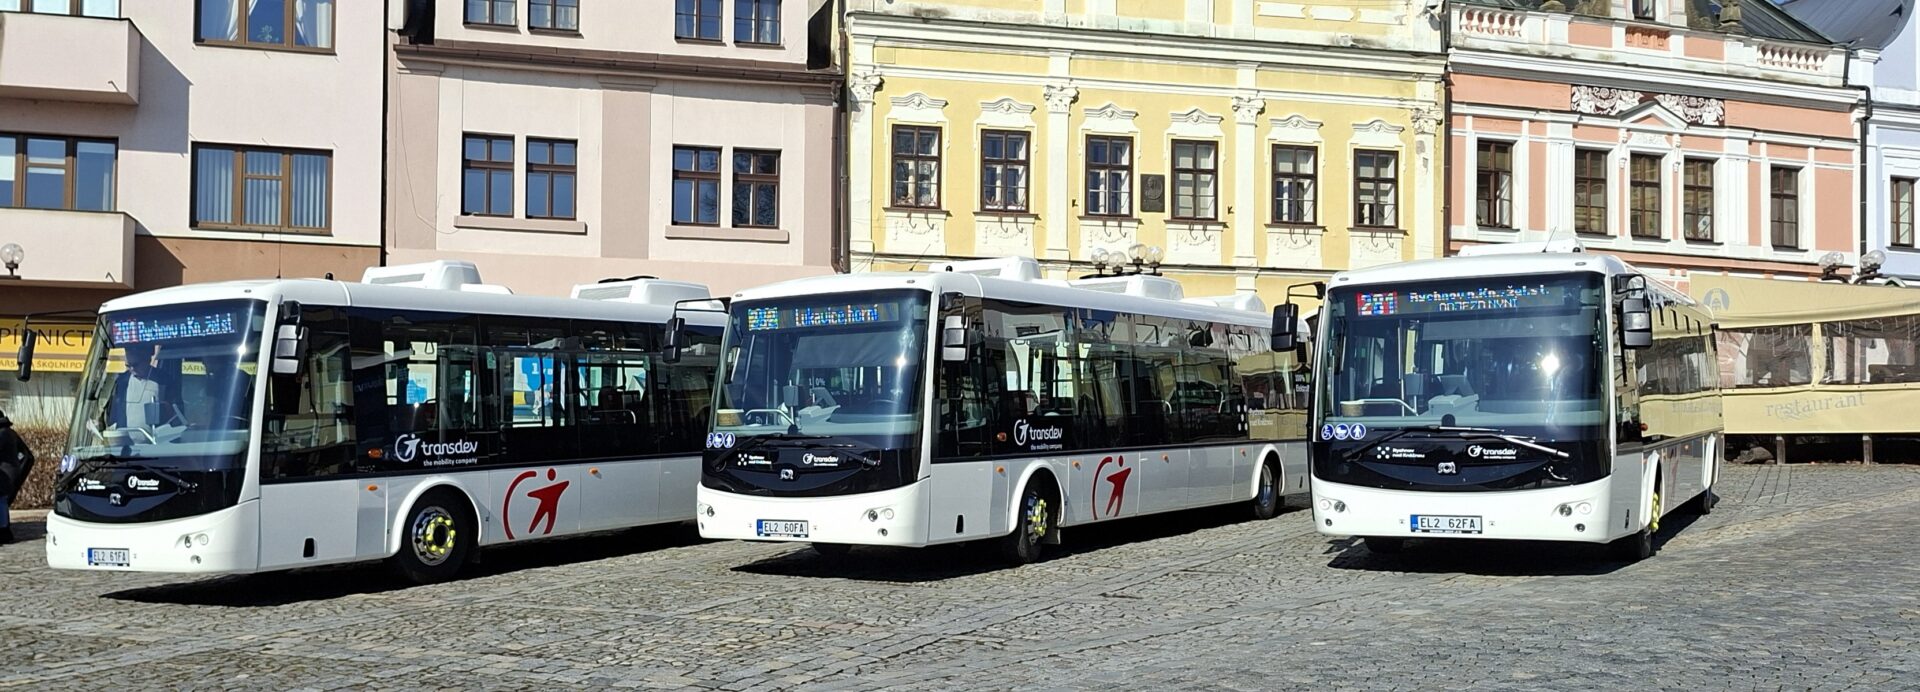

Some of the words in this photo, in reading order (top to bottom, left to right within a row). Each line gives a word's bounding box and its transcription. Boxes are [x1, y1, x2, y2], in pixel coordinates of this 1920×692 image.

[1409, 291, 1465, 302] Rychnov
[0, 323, 94, 347] PÍNICT
[1766, 391, 1865, 417] restaurant
[1029, 425, 1063, 440] transdev
[421, 439, 478, 456] transdev
[1482, 448, 1517, 456] transdev
[764, 522, 779, 533] EL2
[784, 523, 804, 533] 60FA
[1420, 518, 1440, 528] EL2
[1448, 519, 1476, 529] 62FA
[93, 551, 105, 562] EL2
[110, 551, 126, 562] 61FA
